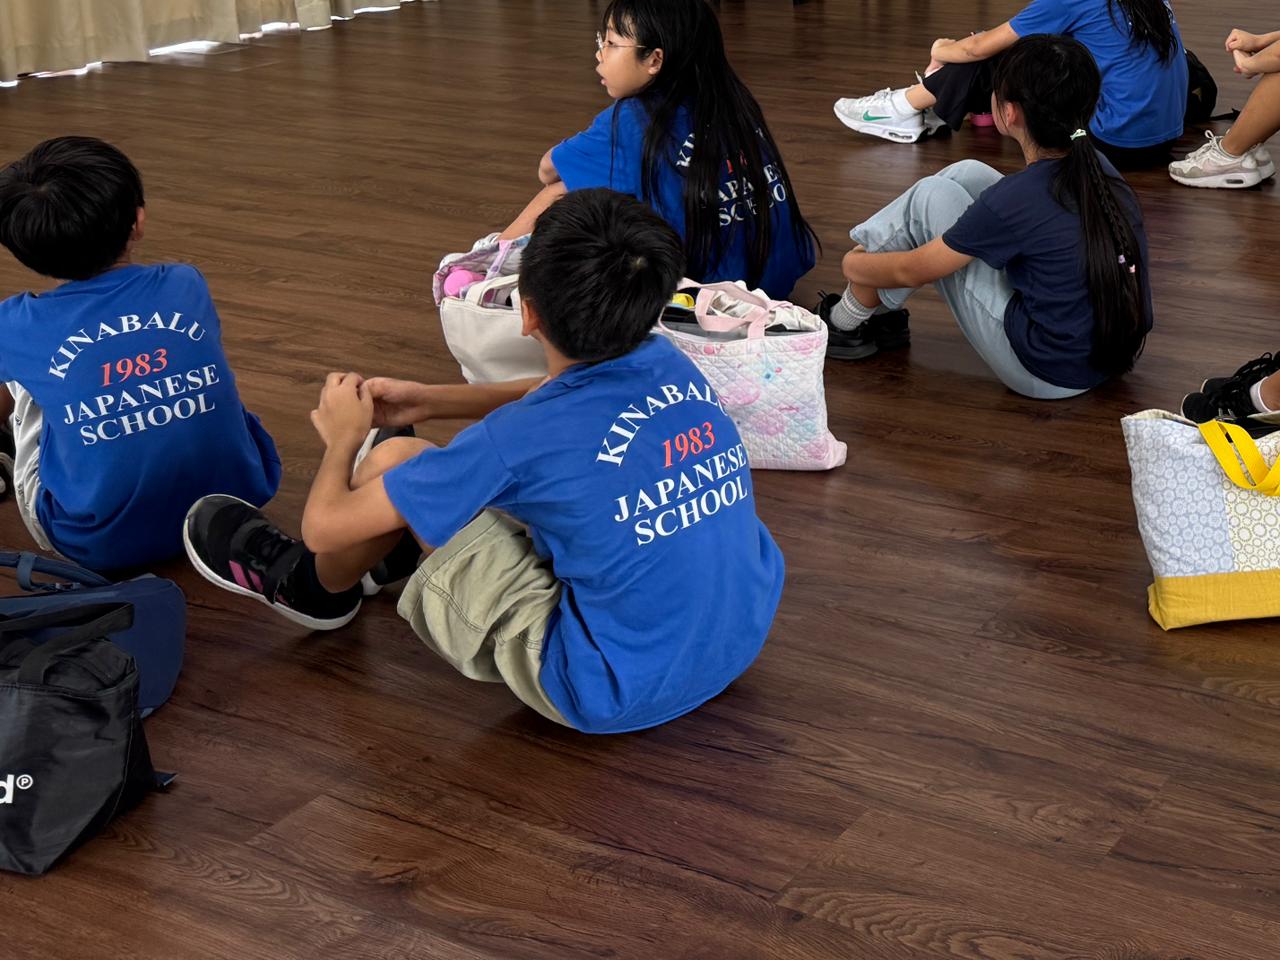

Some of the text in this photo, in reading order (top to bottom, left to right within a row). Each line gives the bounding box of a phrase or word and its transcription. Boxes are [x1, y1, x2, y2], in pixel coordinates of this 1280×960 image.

[48, 311, 206, 380] KINABALU
[101, 348, 169, 388] 1983
[63, 363, 220, 425] JAPANESE
[79, 393, 217, 446] SCHOOL
[596, 381, 728, 468] KINABAL
[662, 421, 716, 468] 1983
[613, 443, 747, 522] JAPANESE
[634, 475, 748, 546] SCHOOL
